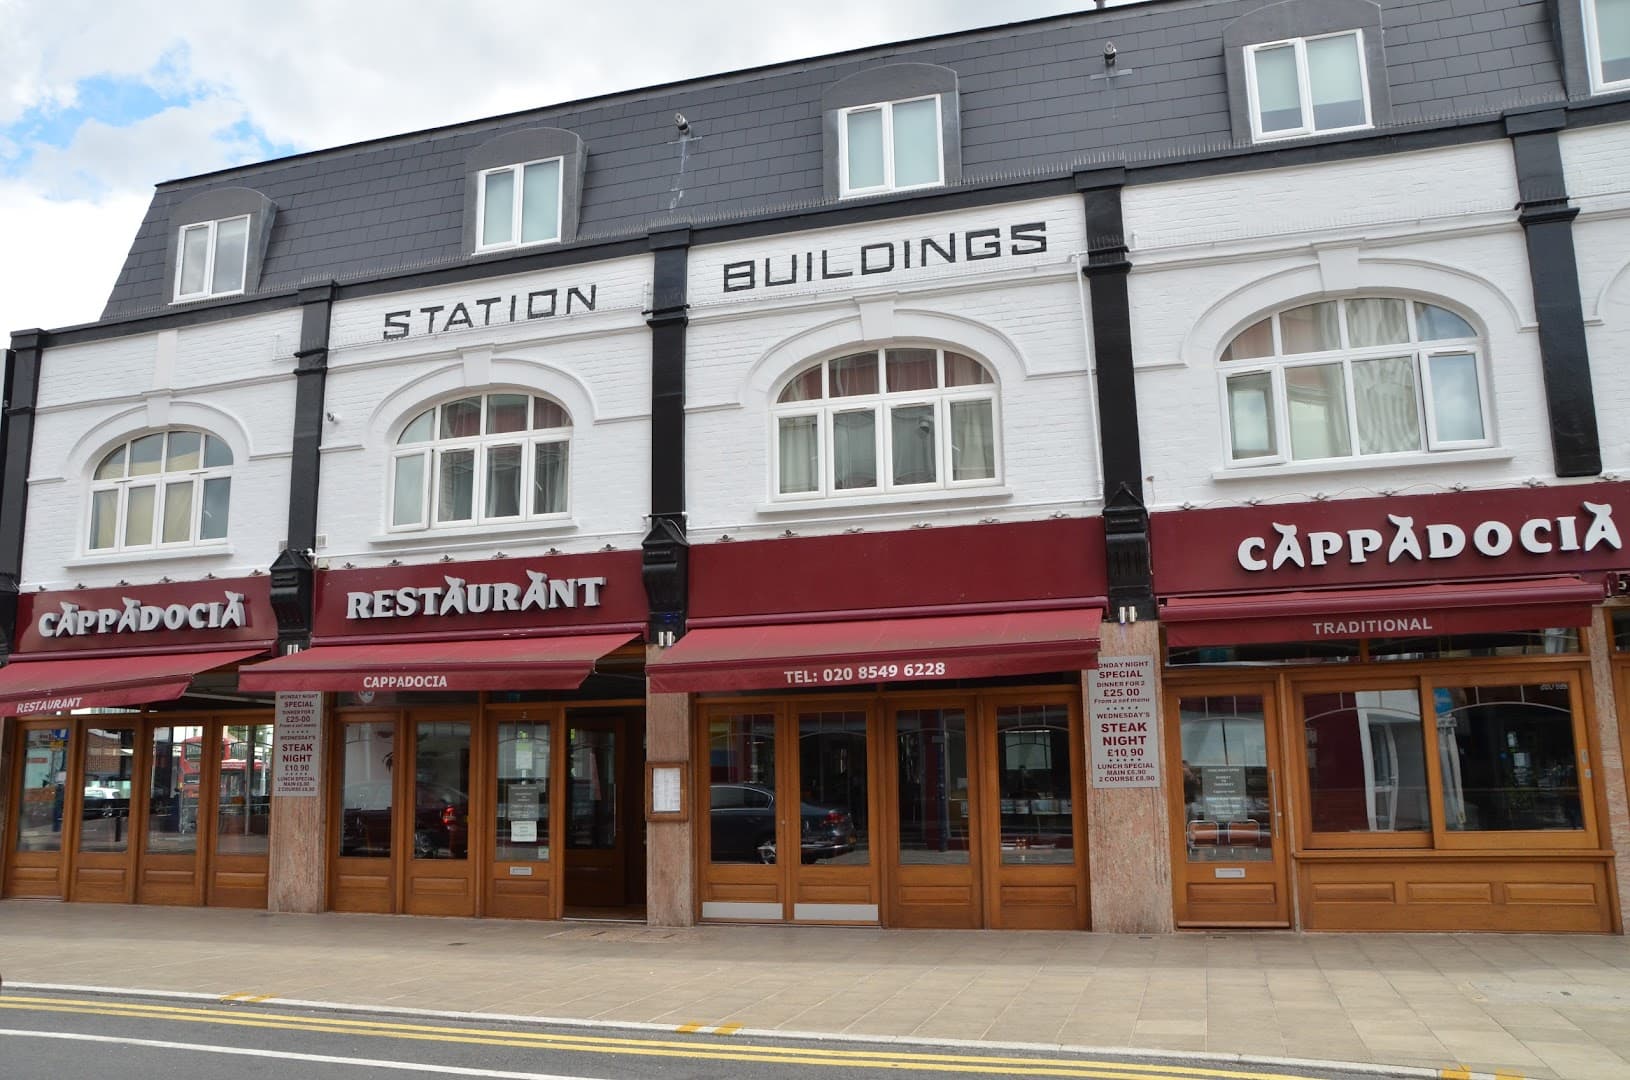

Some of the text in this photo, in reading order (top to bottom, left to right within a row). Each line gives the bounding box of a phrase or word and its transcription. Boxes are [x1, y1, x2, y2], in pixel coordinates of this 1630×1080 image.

[382, 221, 1047, 340] STATION BUILDINGS
[1237, 501, 1623, 571] CAPPADOCIA
[346, 569, 606, 619] RESTAURANT
[38, 590, 246, 637] CAPPADOCIA
[1313, 617, 1433, 635] TRADITIONAL
[363, 674, 448, 688] CAPPADOCIA
[784, 662, 946, 684] TEL: 020 8549 6228
[1099, 670, 1143, 679] SPECIAL
[16, 697, 83, 713] RESTAURANT
[1101, 722, 1147, 733] STEAK
[282, 744, 313, 752] STEAK
[1102, 736, 1147, 746] NIGHT
[282, 754, 312, 762] NIGHT
